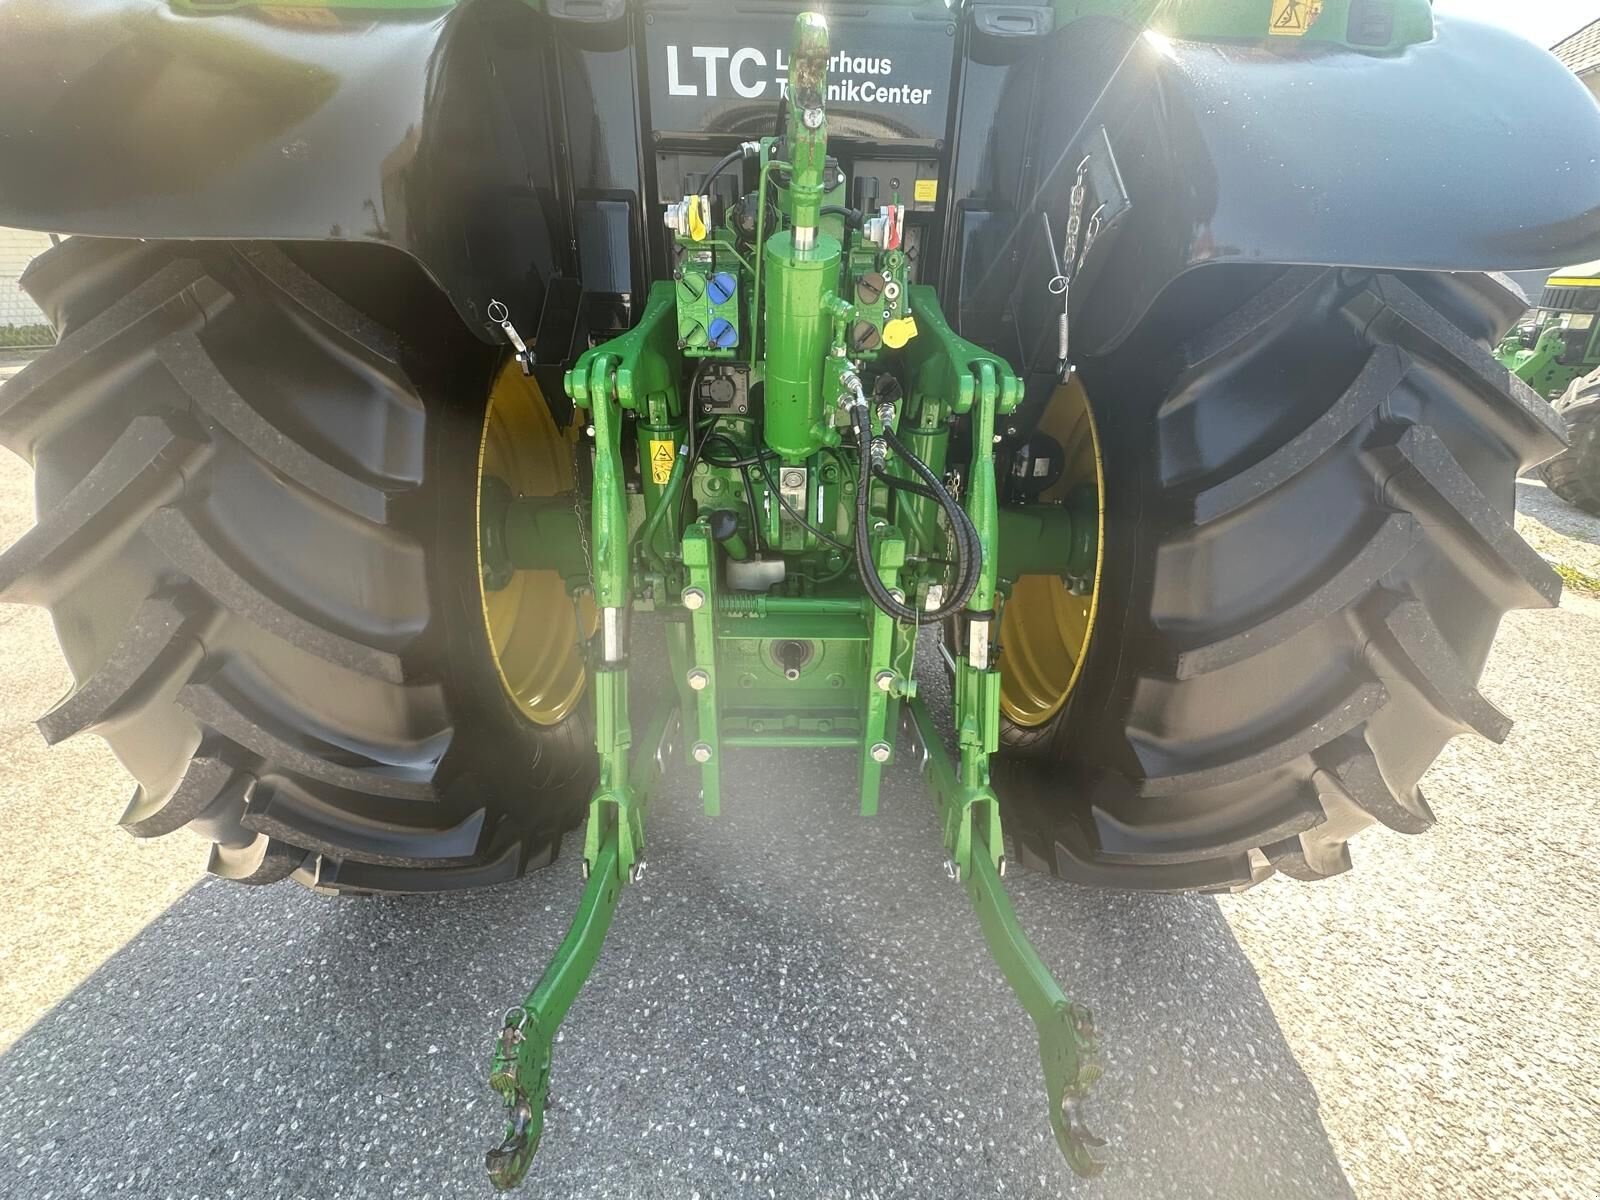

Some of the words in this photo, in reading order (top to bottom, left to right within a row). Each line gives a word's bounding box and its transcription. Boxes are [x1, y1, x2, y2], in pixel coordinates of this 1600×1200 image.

[666, 45, 767, 98] LTC
[776, 49, 892, 75] Lrhaus
[775, 78, 932, 105] TnikCenter
